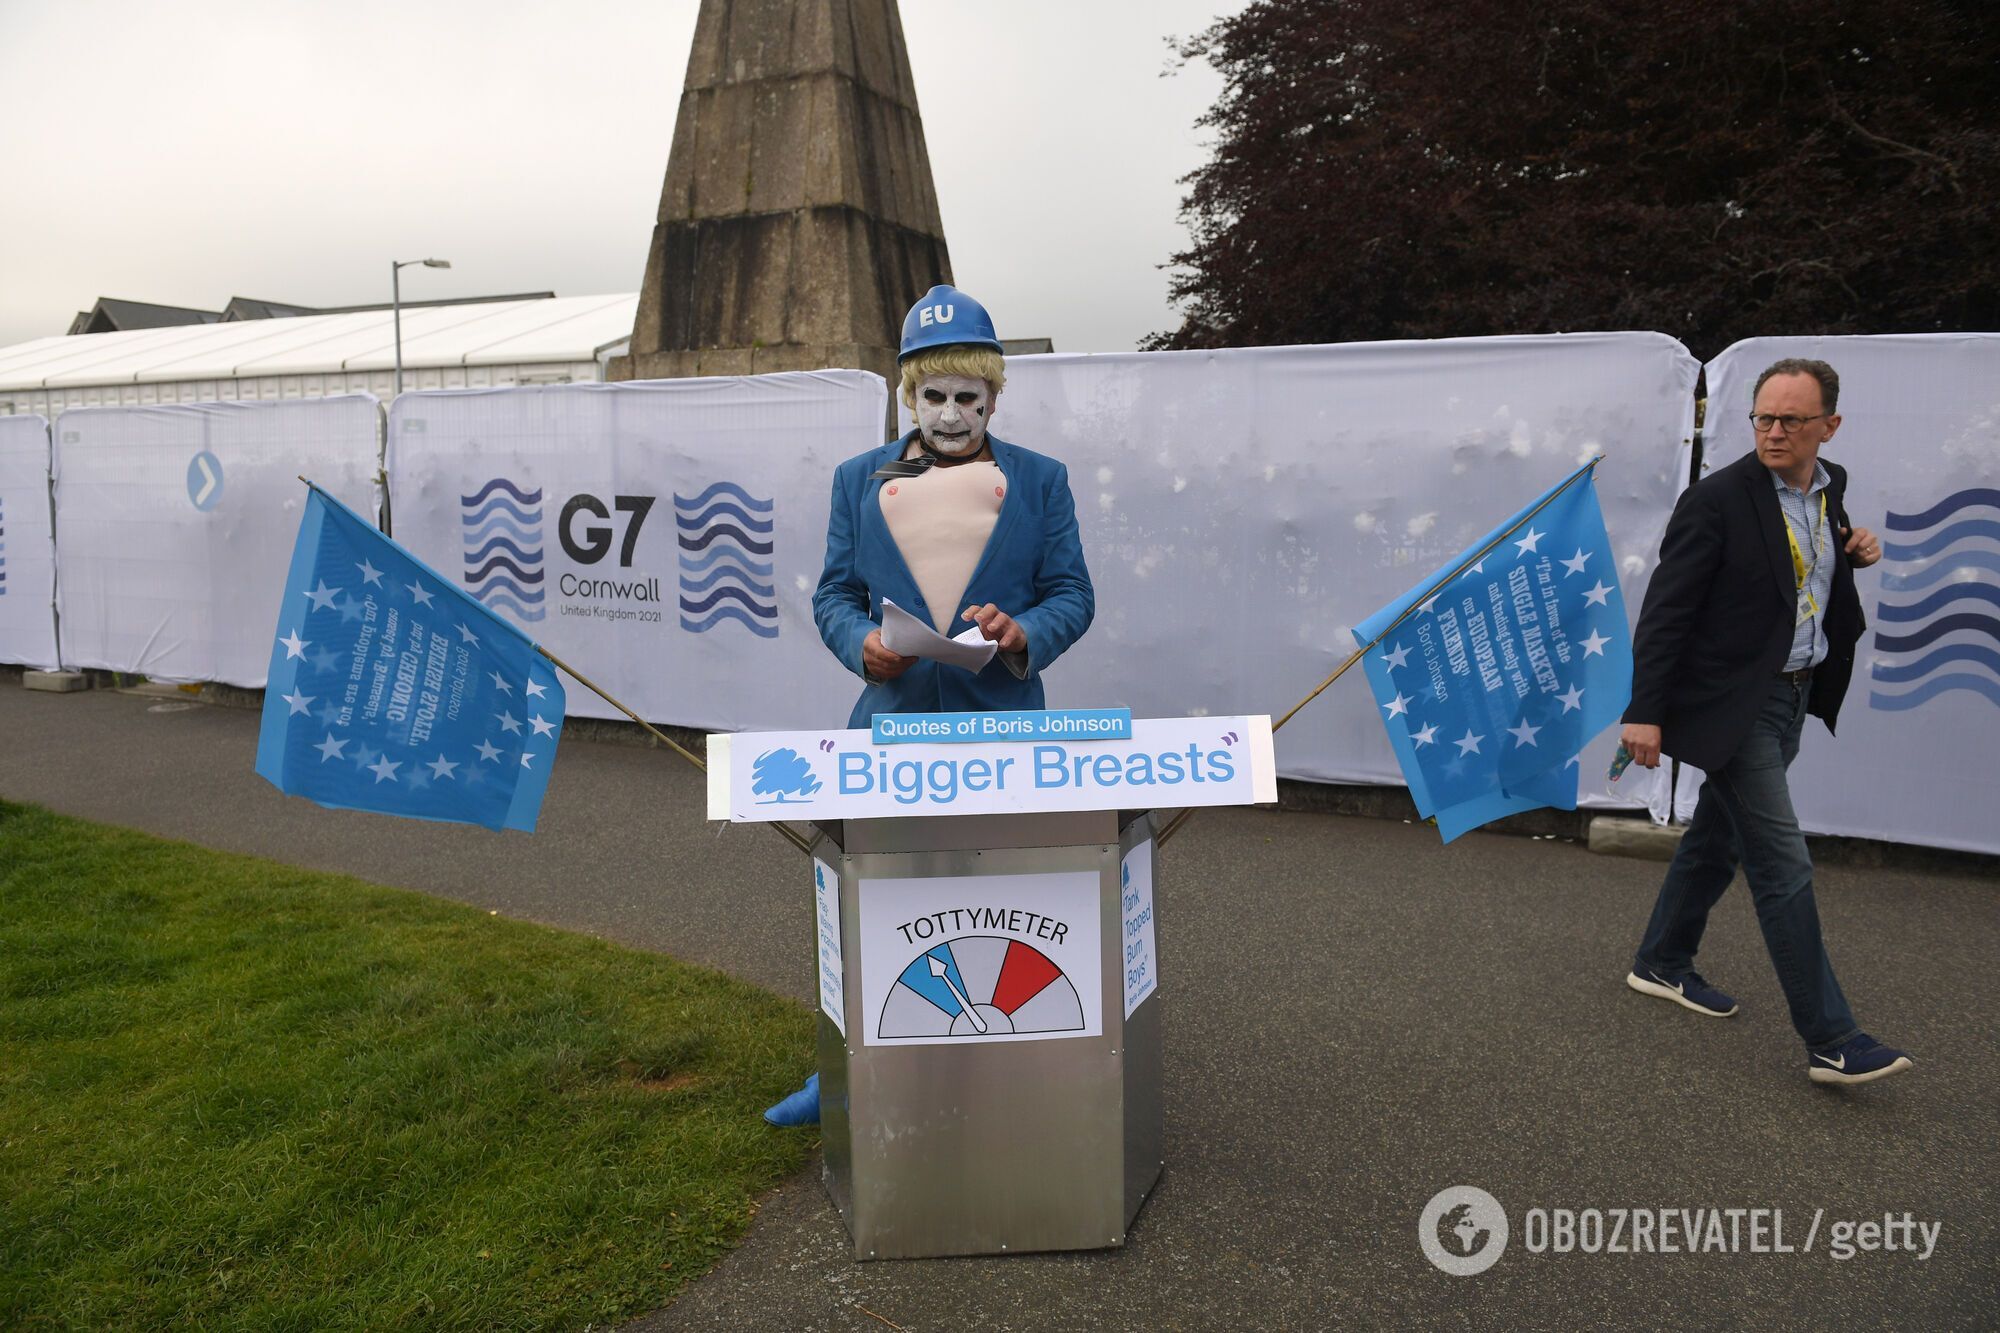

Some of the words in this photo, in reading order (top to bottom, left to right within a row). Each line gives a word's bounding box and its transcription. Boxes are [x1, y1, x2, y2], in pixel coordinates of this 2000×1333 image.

[919, 304, 954, 328] EU
[558, 493, 657, 568] G7
[560, 573, 661, 602] Cornwall
[1488, 582, 1504, 604] and
[1508, 565, 1538, 626] SINGLE
[1542, 585, 1557, 599] in
[560, 604, 592, 617] United
[593, 606, 637, 621] Kingdom
[639, 610, 662, 622] 2021
[1462, 597, 1475, 616] our
[1490, 599, 1511, 642] trading
[1544, 598, 1560, 631] favour
[1416, 622, 1437, 657] Boris
[1467, 611, 1504, 693] EUROPEAN
[1551, 629, 1566, 642] of
[1501, 635, 1519, 671] freely
[1521, 624, 1561, 694] MARKET
[1556, 641, 1571, 664] the
[1426, 654, 1449, 703] Johnson
[1511, 666, 1531, 699] with
[879, 719, 951, 737] Quotes
[957, 717, 977, 735] of
[982, 716, 1033, 734] Boris
[1038, 714, 1124, 733] Johnson
[896, 907, 1069, 945] TOTTYMETER
[1125, 902, 1151, 939] Topped
[1127, 939, 1143, 965] Bum
